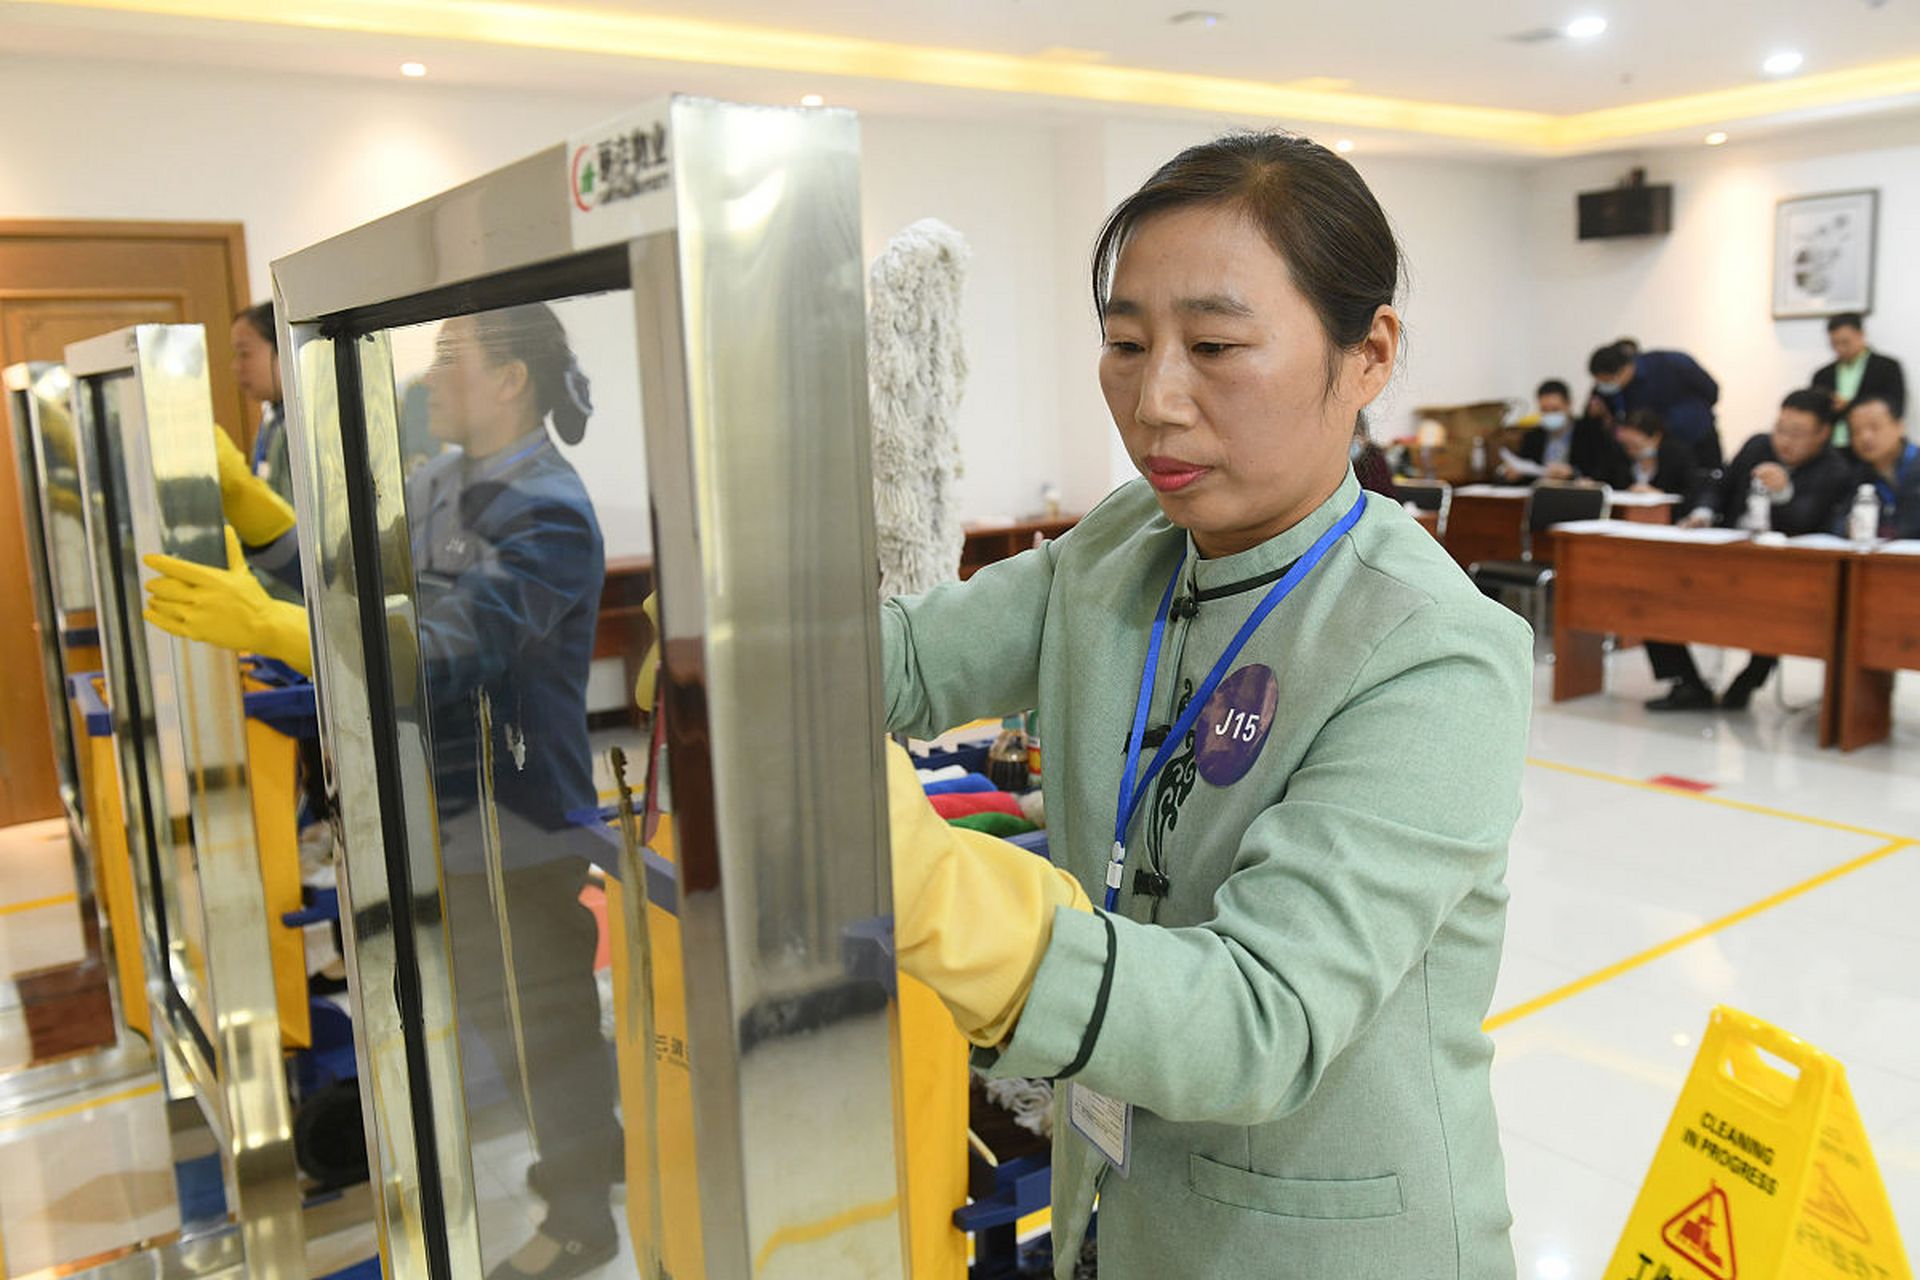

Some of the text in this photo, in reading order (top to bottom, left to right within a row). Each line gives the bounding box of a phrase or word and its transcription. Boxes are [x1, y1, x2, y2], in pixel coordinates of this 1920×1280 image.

[1215, 708, 1260, 742] J15
[1682, 1127, 1699, 1149] IN
[1700, 1138, 1778, 1196] PROGRESS
[1701, 1111, 1775, 1166] CLEANING
